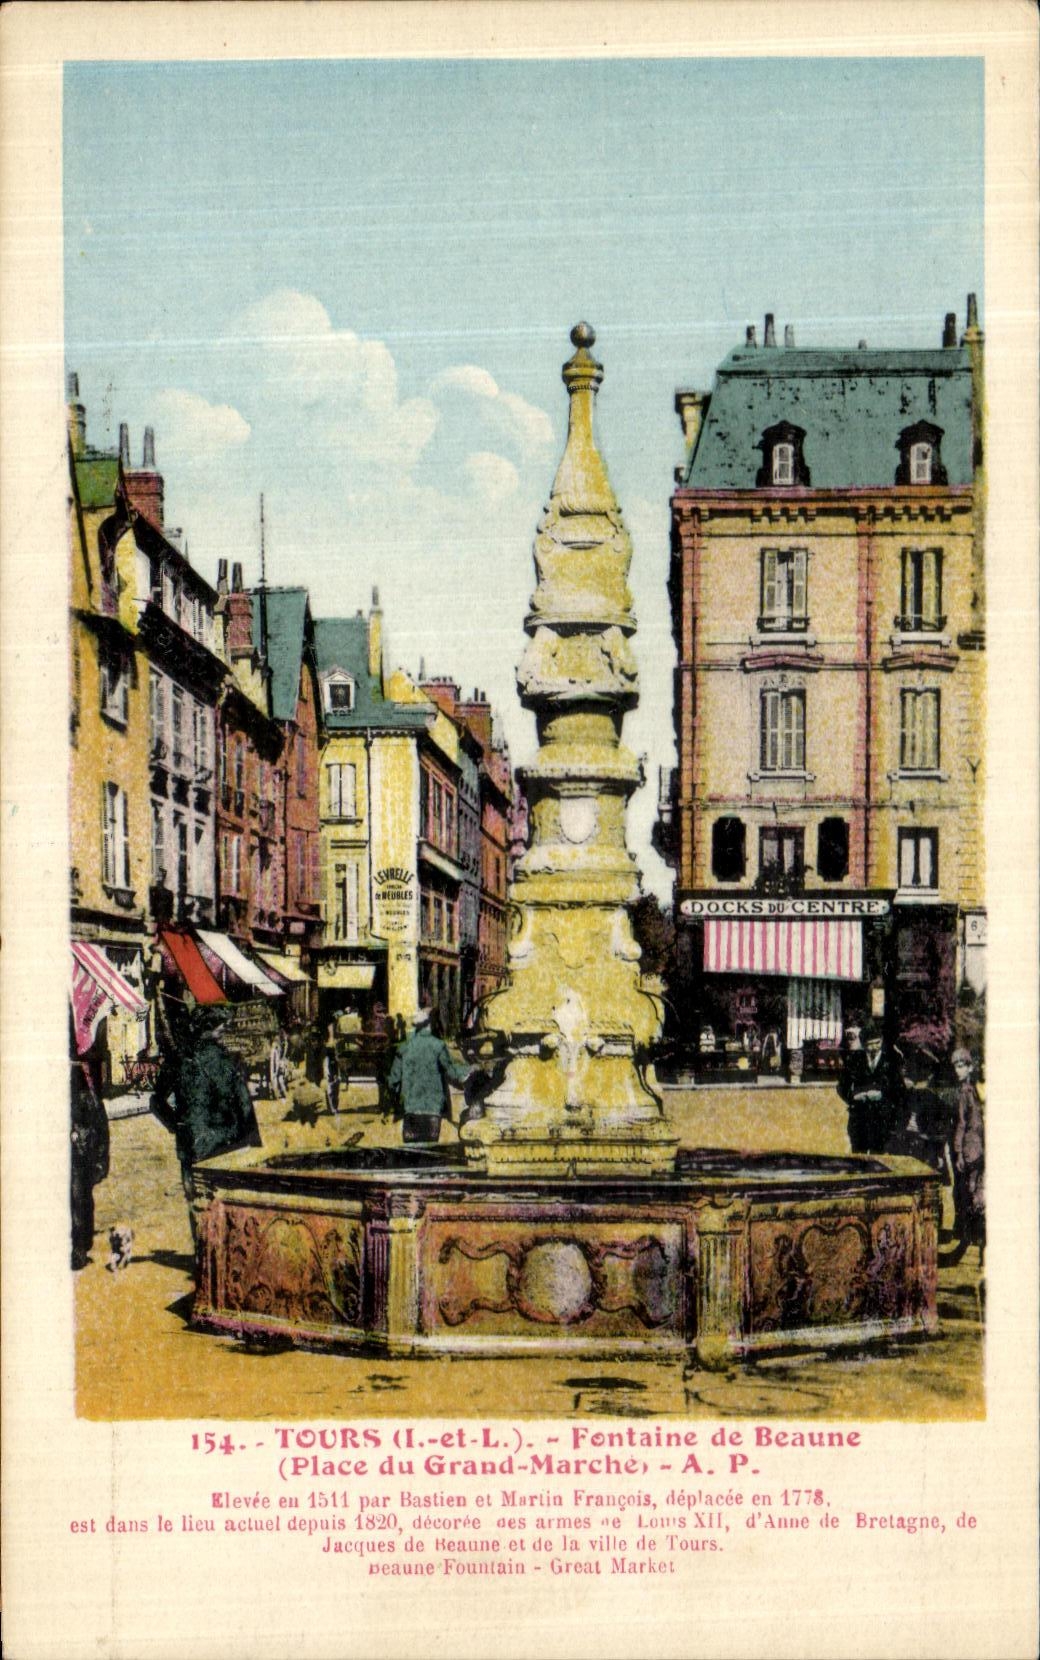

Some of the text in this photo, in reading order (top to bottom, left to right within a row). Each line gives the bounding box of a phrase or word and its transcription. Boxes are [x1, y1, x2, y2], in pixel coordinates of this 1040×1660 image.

[381, 890, 413, 900] MEUBLES
[690, 900, 880, 914] DOCKS DU CENTRE
